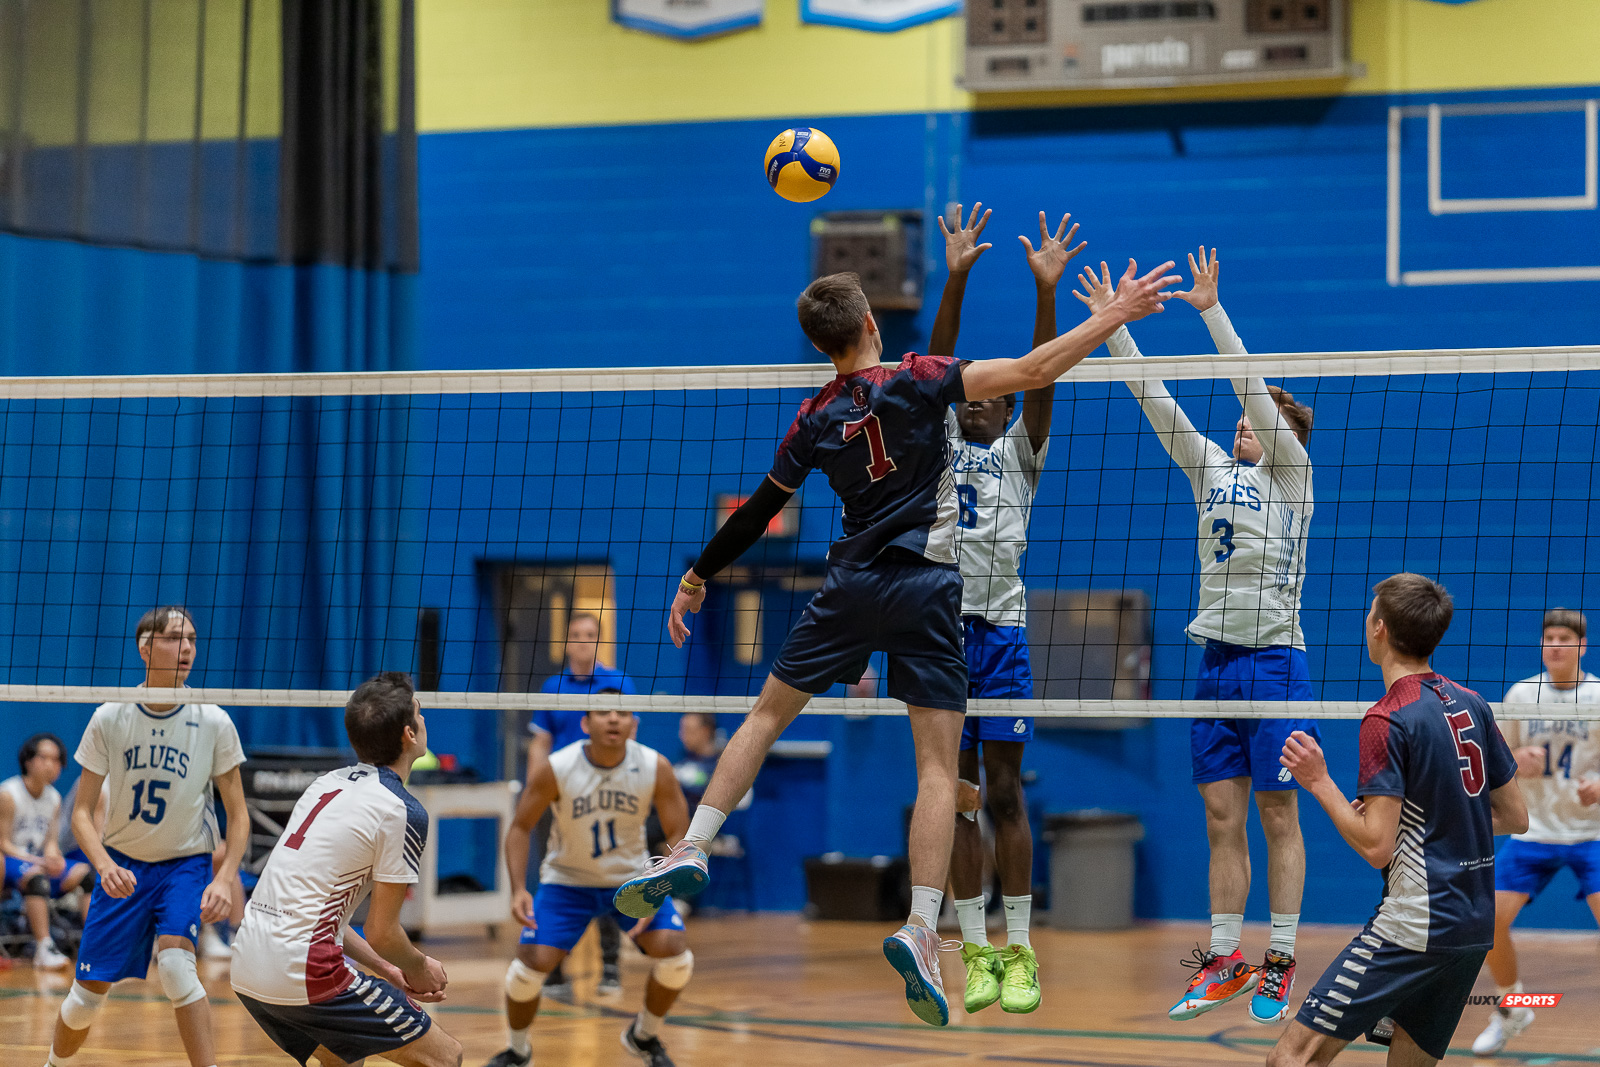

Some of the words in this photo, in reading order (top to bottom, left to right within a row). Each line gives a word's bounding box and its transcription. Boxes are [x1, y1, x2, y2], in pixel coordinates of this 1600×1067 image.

[842, 410, 898, 483] 7
[1211, 518, 1236, 563] 3
[1443, 708, 1486, 798] 5
[1543, 741, 1574, 780] 14
[128, 779, 171, 825] 15
[284, 788, 342, 850] 1
[573, 788, 639, 820] BLUES
[591, 819, 618, 859] 11
[1218, 968, 1230, 981] 13
